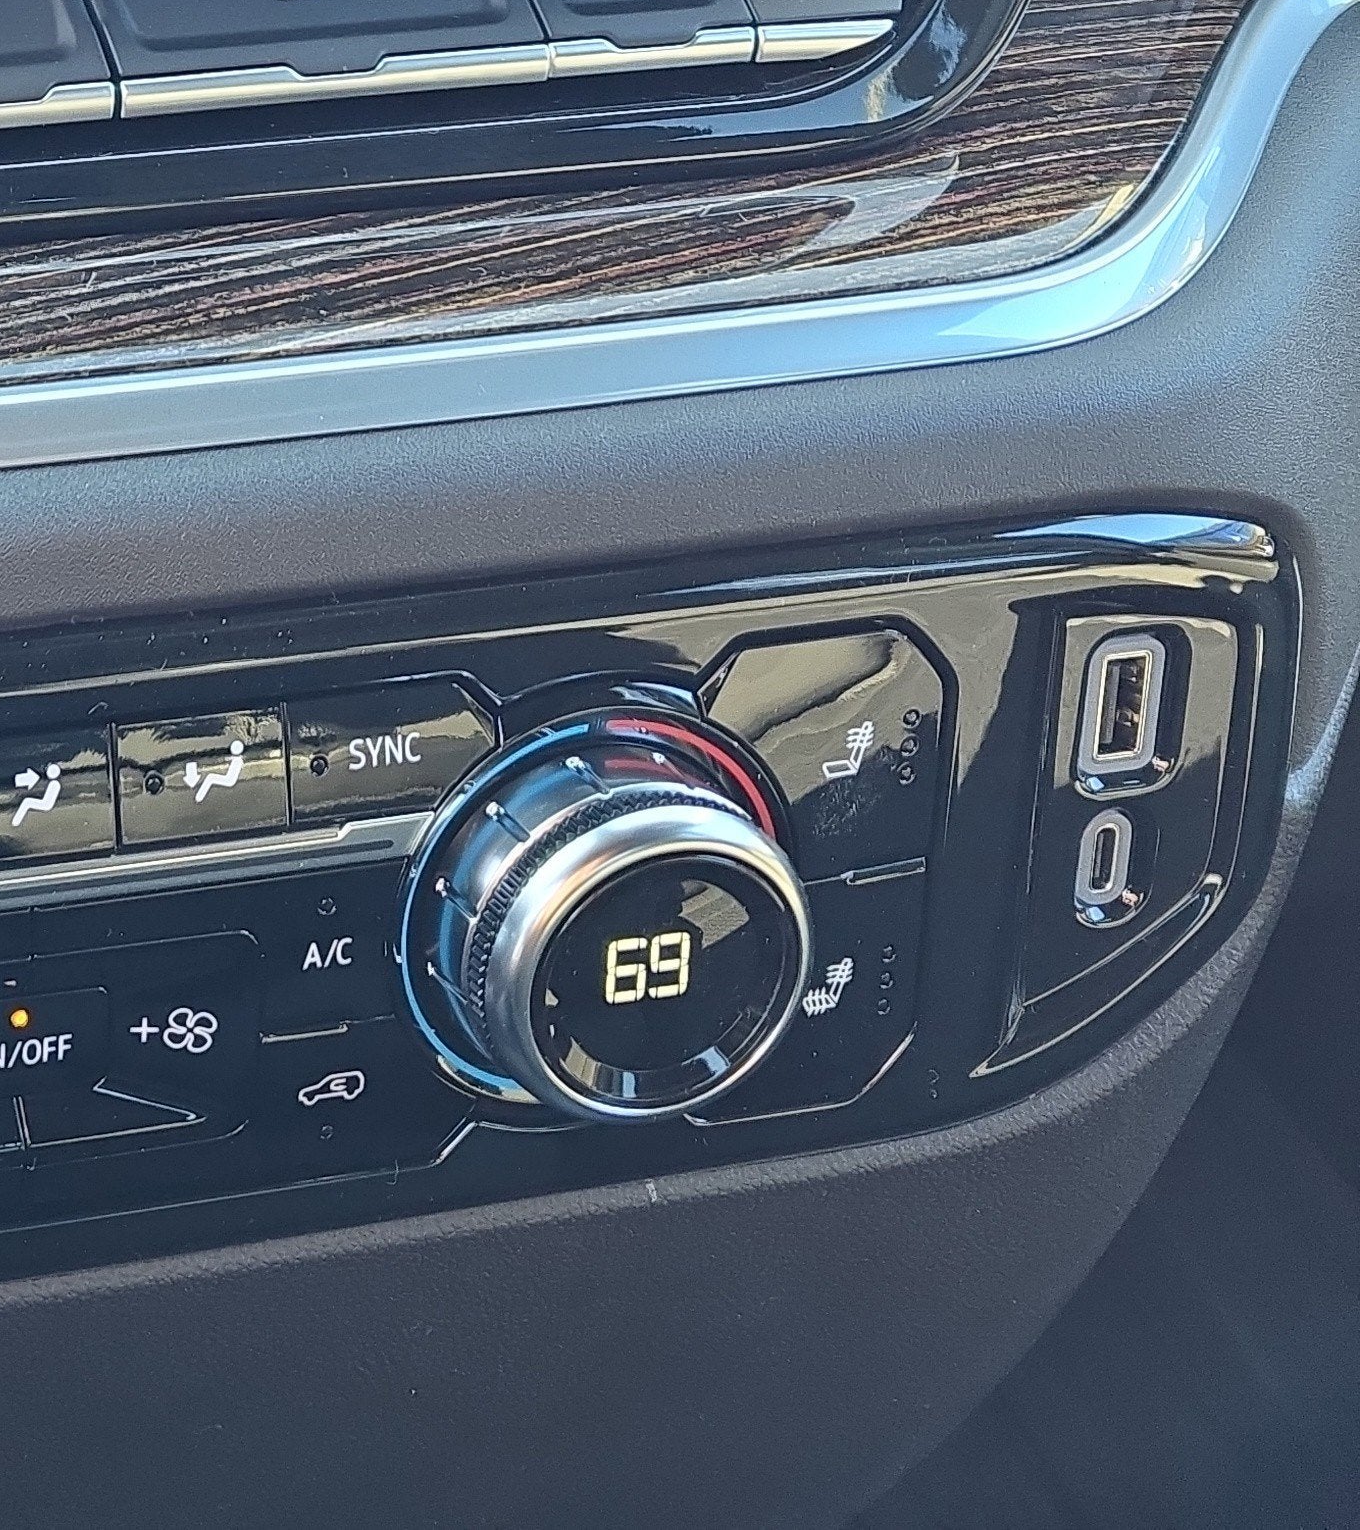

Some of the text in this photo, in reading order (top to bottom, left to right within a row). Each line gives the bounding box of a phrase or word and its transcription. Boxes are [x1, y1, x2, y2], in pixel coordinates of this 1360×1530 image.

[347, 730, 422, 770] SYNC
[302, 936, 354, 970] A/C
[604, 932, 690, 1004] 69
